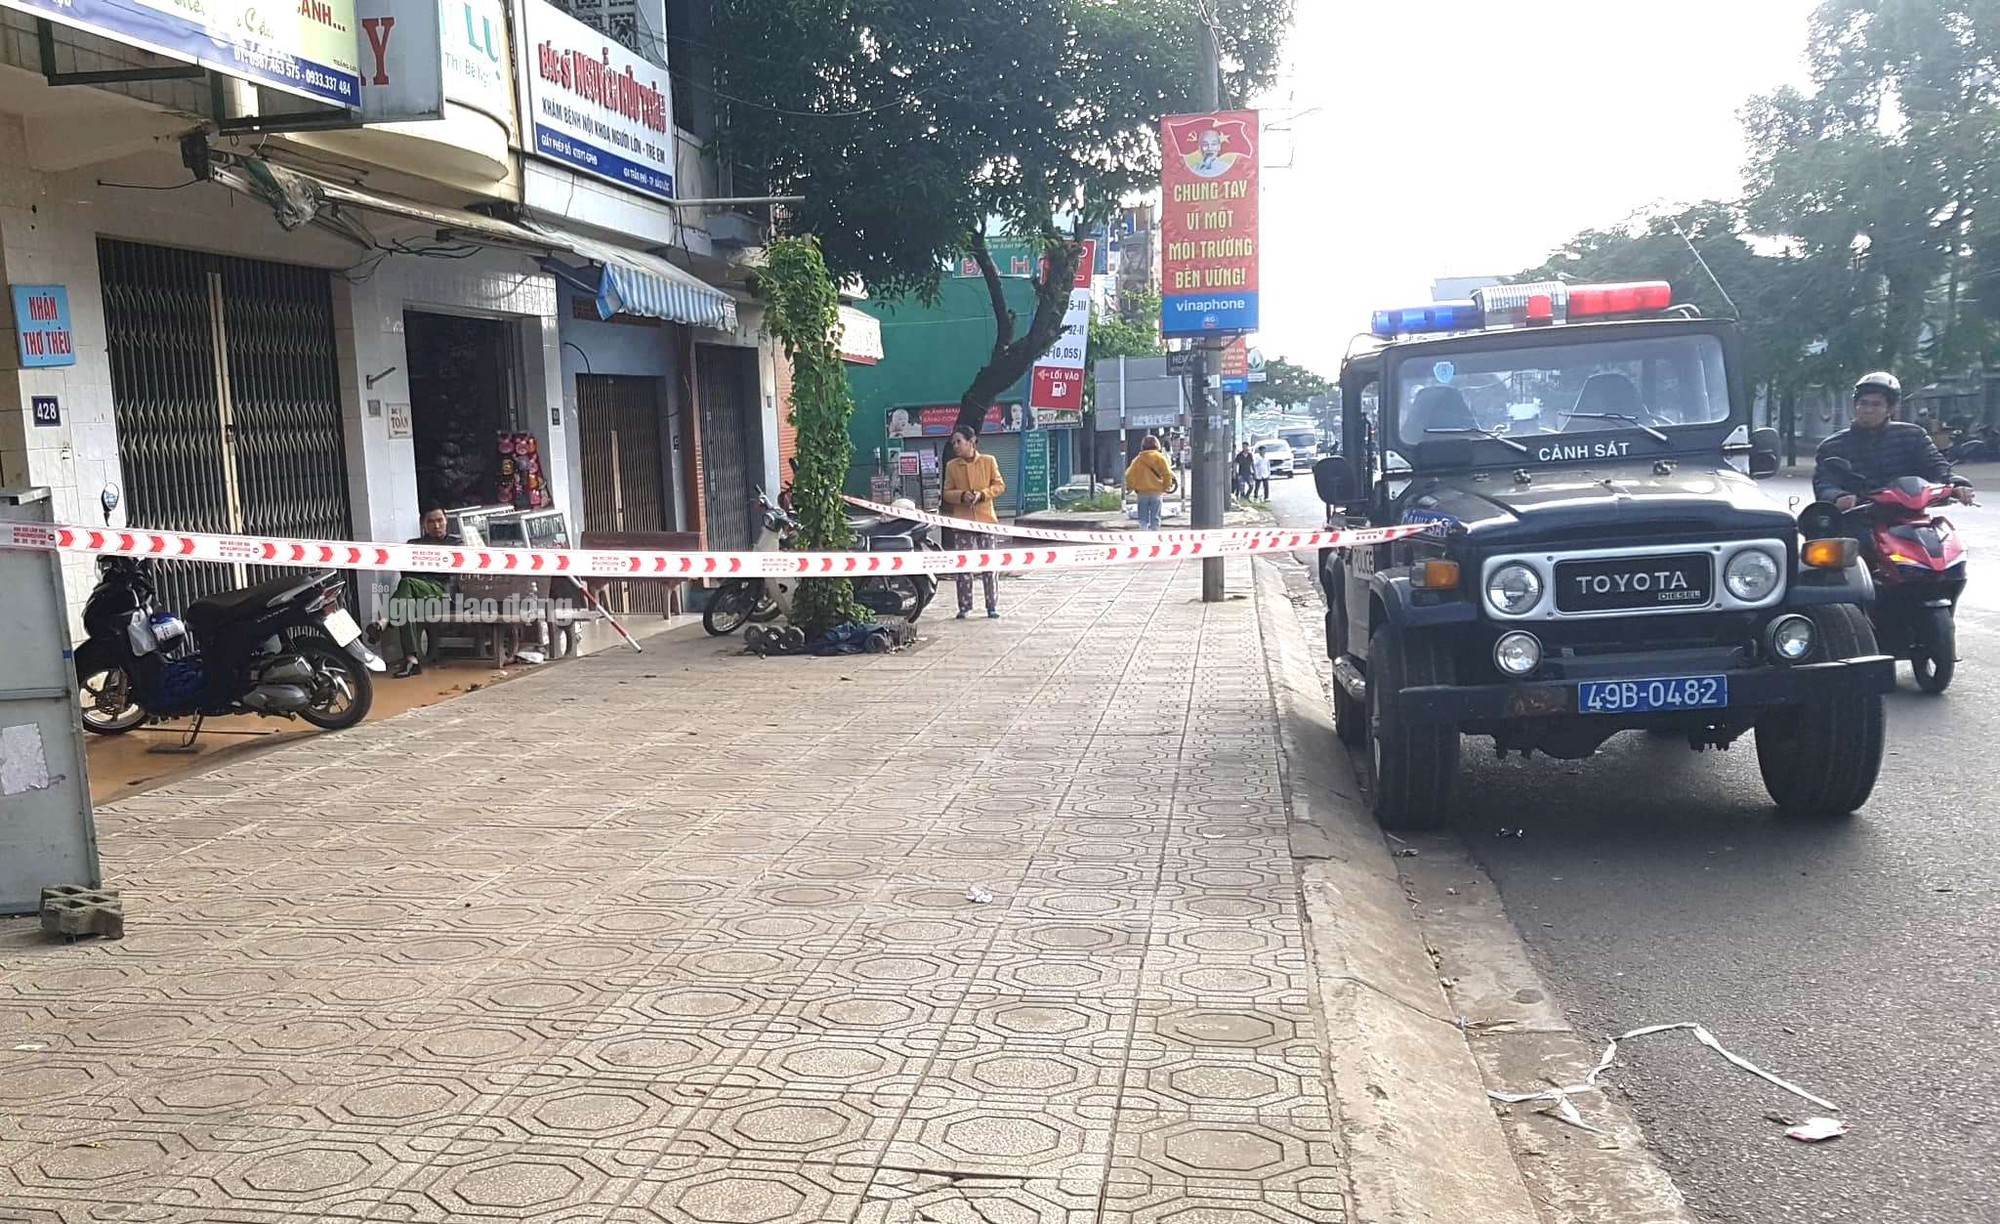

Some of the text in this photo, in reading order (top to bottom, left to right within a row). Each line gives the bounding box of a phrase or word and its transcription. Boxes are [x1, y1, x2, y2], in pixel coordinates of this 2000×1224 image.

[542, 97, 562, 121] KHÁM
[564, 105, 581, 129] BỆNH
[1174, 180, 1247, 202] CHUNG TAY
[1205, 207, 1233, 232] MỘT
[1169, 236, 1253, 261] MÔI TRƯỜNG
[28, 292, 58, 325] NHẬN
[1176, 299, 1245, 314] vinaphone
[23, 327, 71, 360] THỢ THÊU
[37, 402, 57, 421] 428
[1539, 440, 1630, 461] CẢNH SÁT
[1576, 570, 1688, 594] TOYOTA
[1658, 590, 1701, 601] DIESEL
[1587, 678, 1718, 710] 49B-0482
